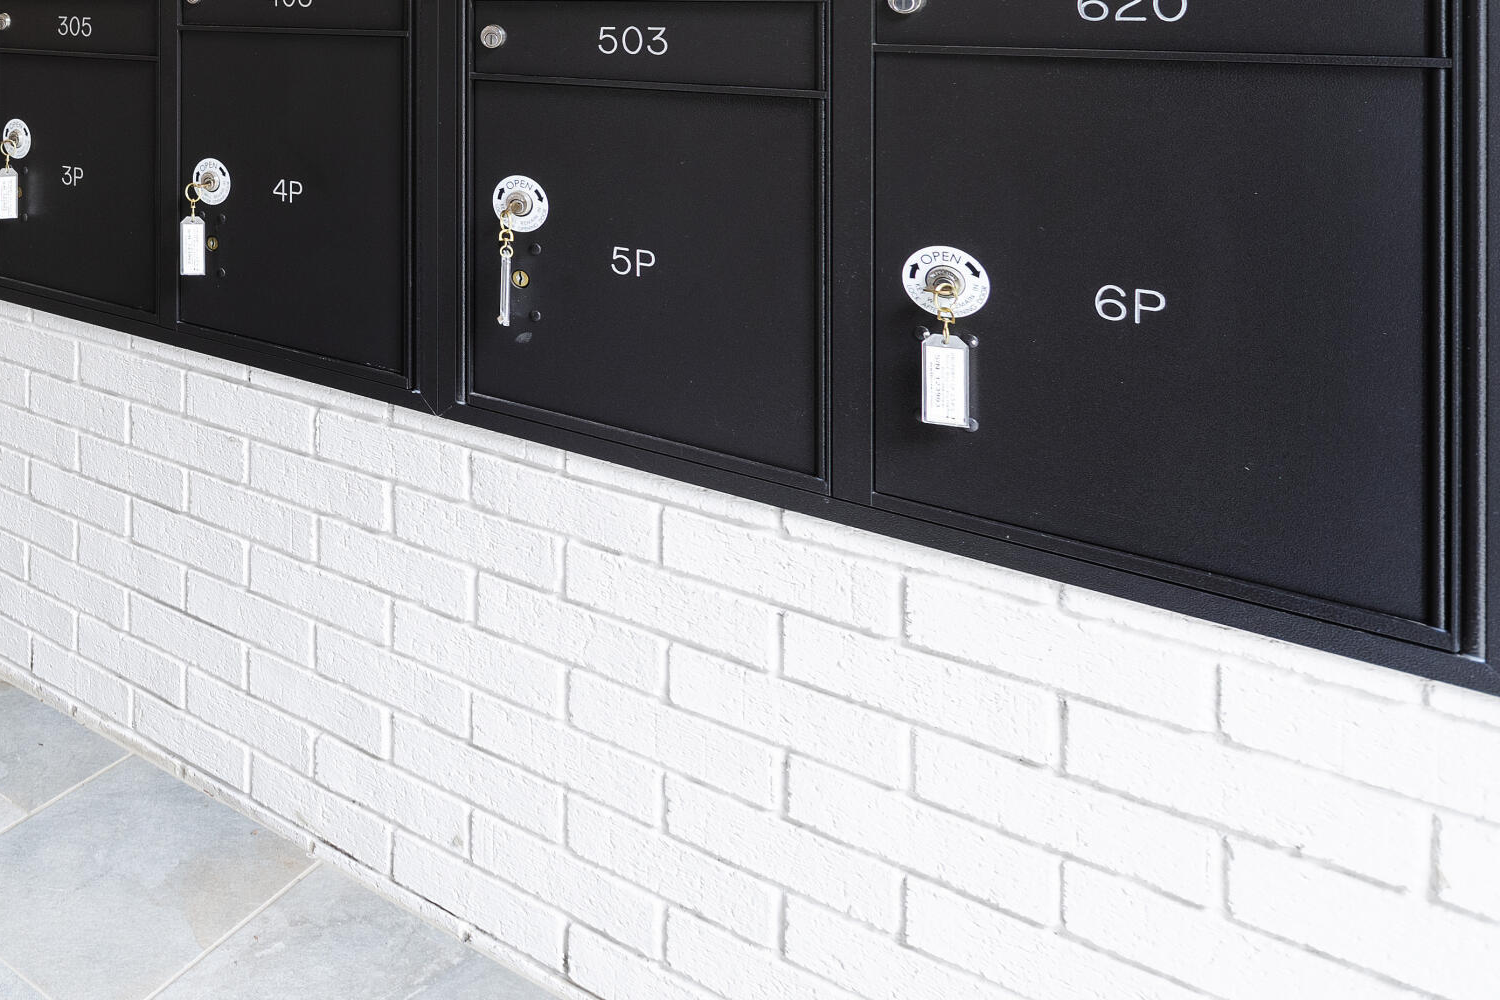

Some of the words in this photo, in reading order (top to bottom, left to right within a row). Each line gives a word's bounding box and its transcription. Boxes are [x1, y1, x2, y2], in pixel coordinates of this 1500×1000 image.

[57, 15, 92, 37] 305
[598, 25, 668, 56] 503
[61, 165, 84, 187] 3P
[200, 161, 218, 172] OPEN
[272, 178, 303, 204] 4P
[506, 179, 534, 191] OPEN
[610, 246, 656, 277] 5P
[920, 251, 962, 265] OPEN
[1094, 284, 1166, 324] 6P
